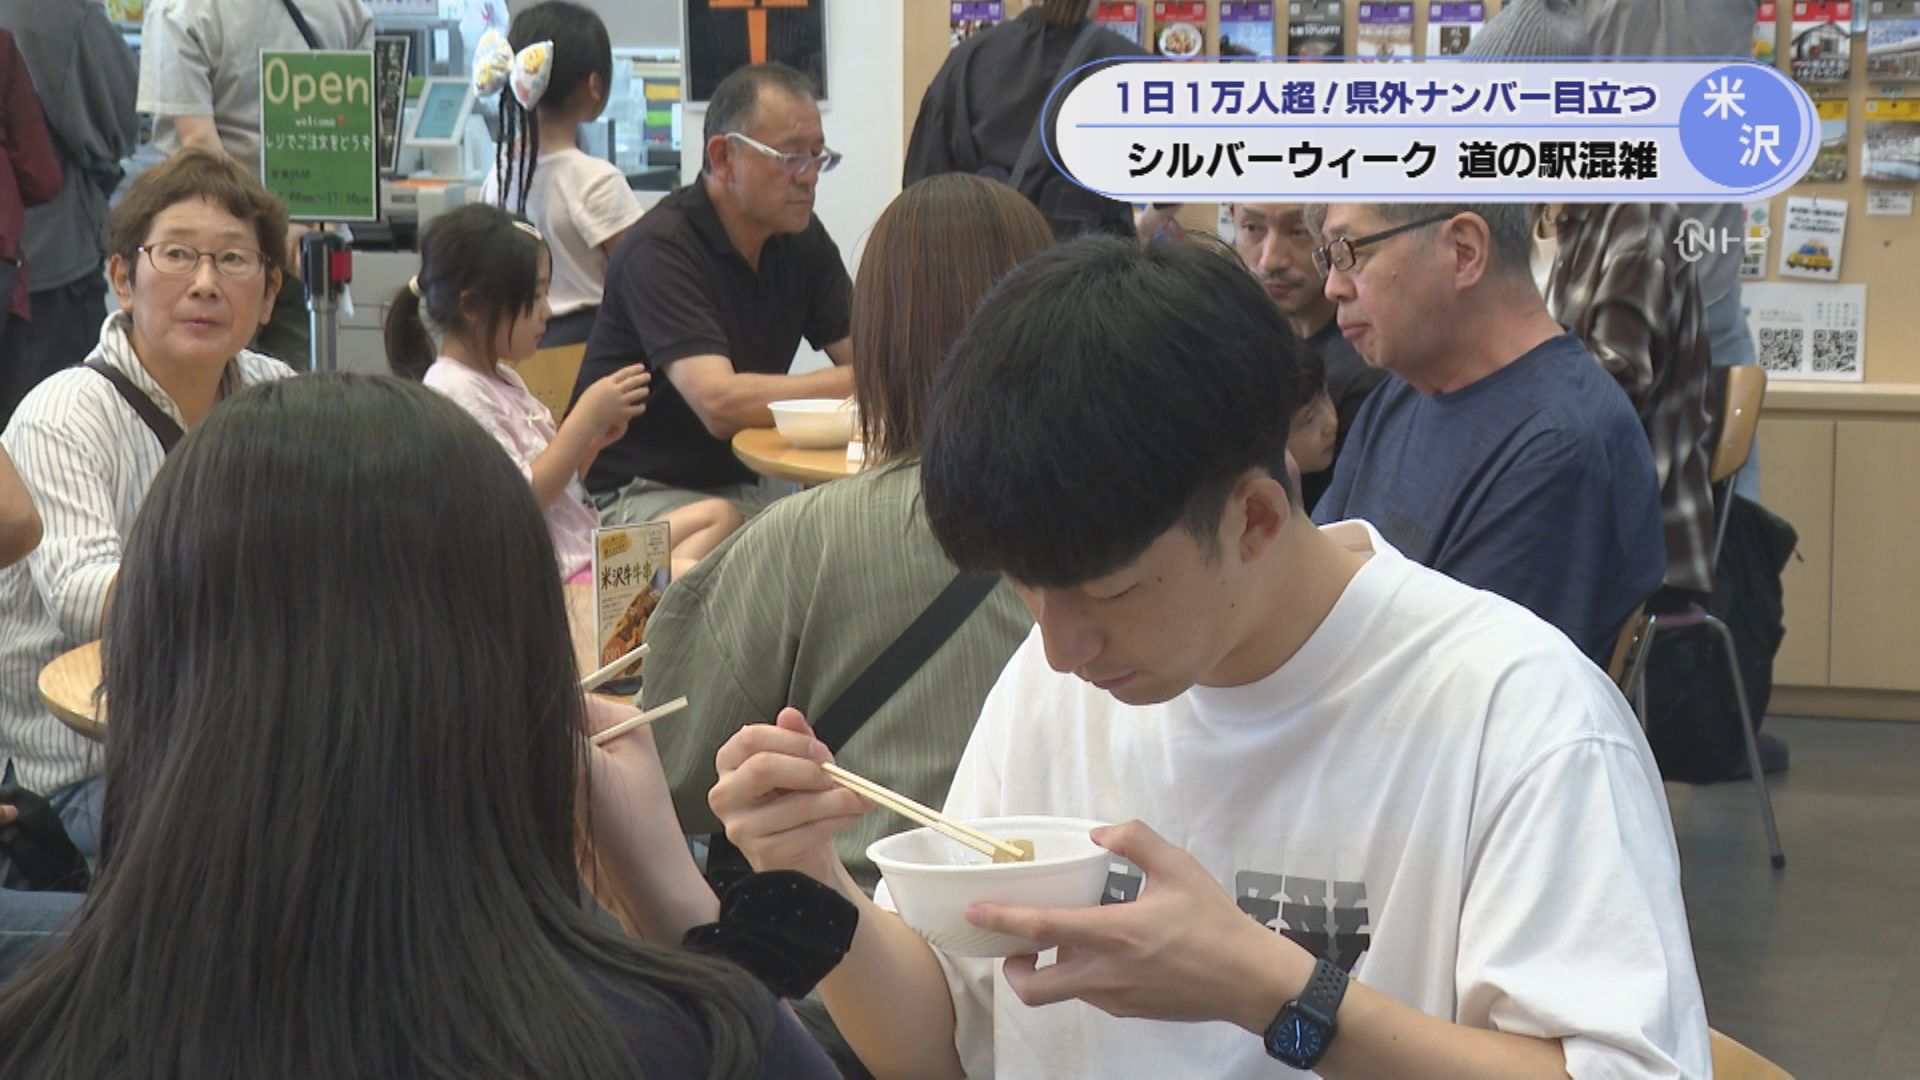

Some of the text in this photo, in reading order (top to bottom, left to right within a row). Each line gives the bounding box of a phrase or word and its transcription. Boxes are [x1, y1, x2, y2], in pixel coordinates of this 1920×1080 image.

[265, 58, 369, 111] Open
[264, 134, 371, 152] レジでご注文をどうぞ
